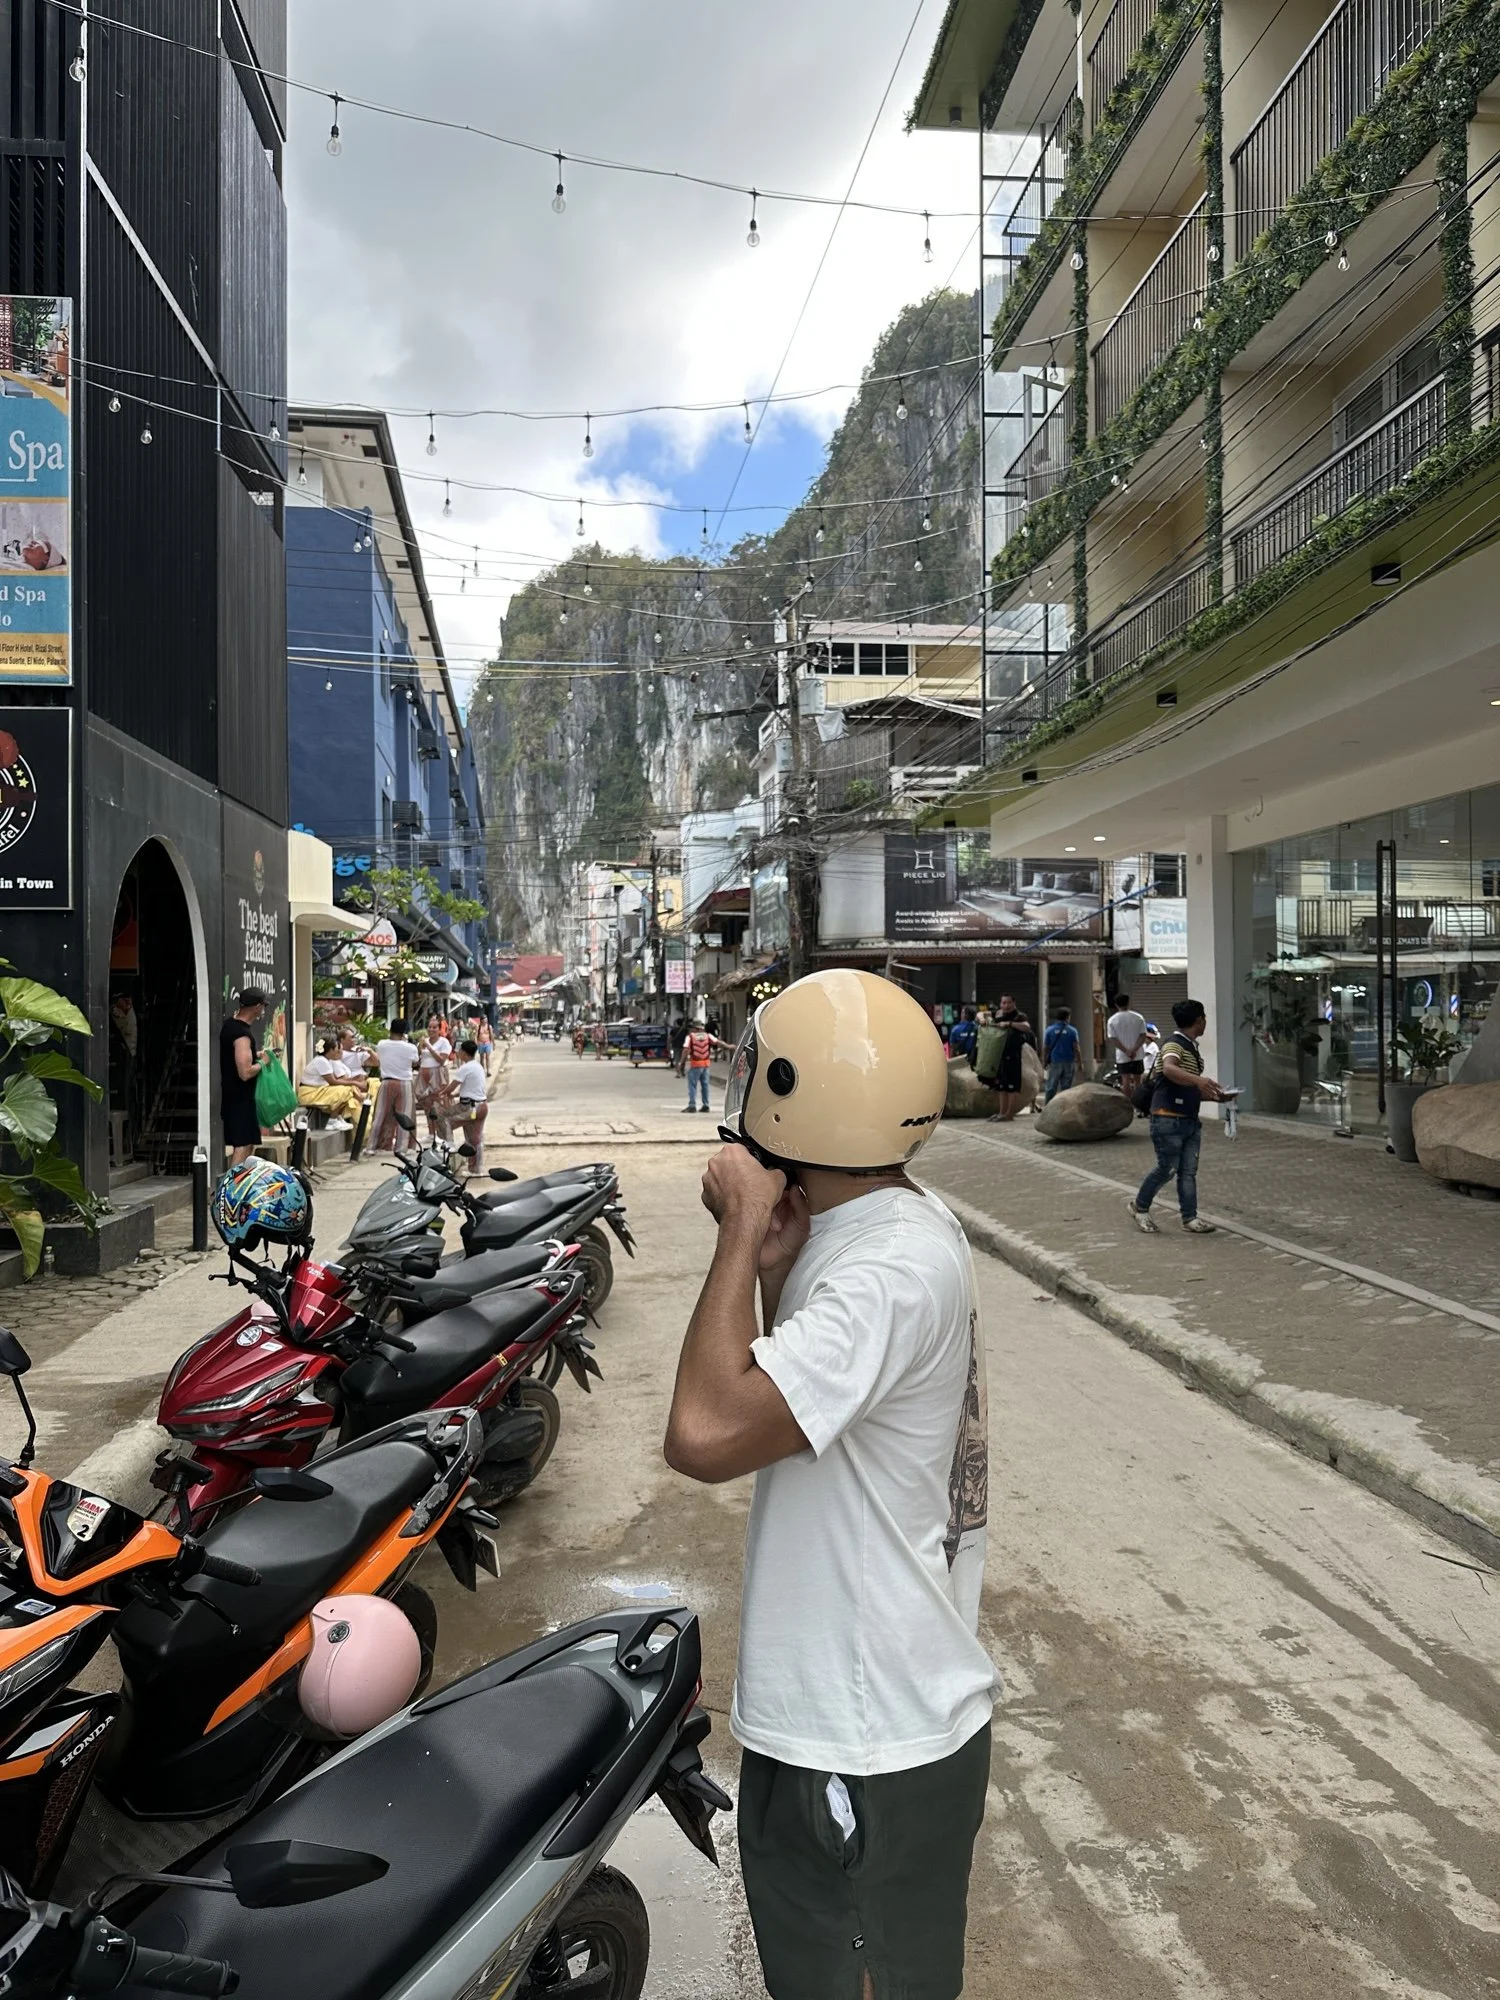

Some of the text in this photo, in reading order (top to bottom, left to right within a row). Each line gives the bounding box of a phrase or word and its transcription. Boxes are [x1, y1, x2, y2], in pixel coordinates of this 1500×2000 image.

[8, 429, 65, 482] Spa
[14, 585, 46, 606] Spa
[0, 877, 54, 889] in Town
[903, 871, 946, 879] PIECE LIO
[238, 897, 278, 938] The best
[245, 931, 274, 966] falafel
[243, 963, 276, 995] in town.
[264, 1410, 299, 1426] HONDA
[76, 1523, 90, 1539] 2
[59, 1714, 116, 1768] HONDA
